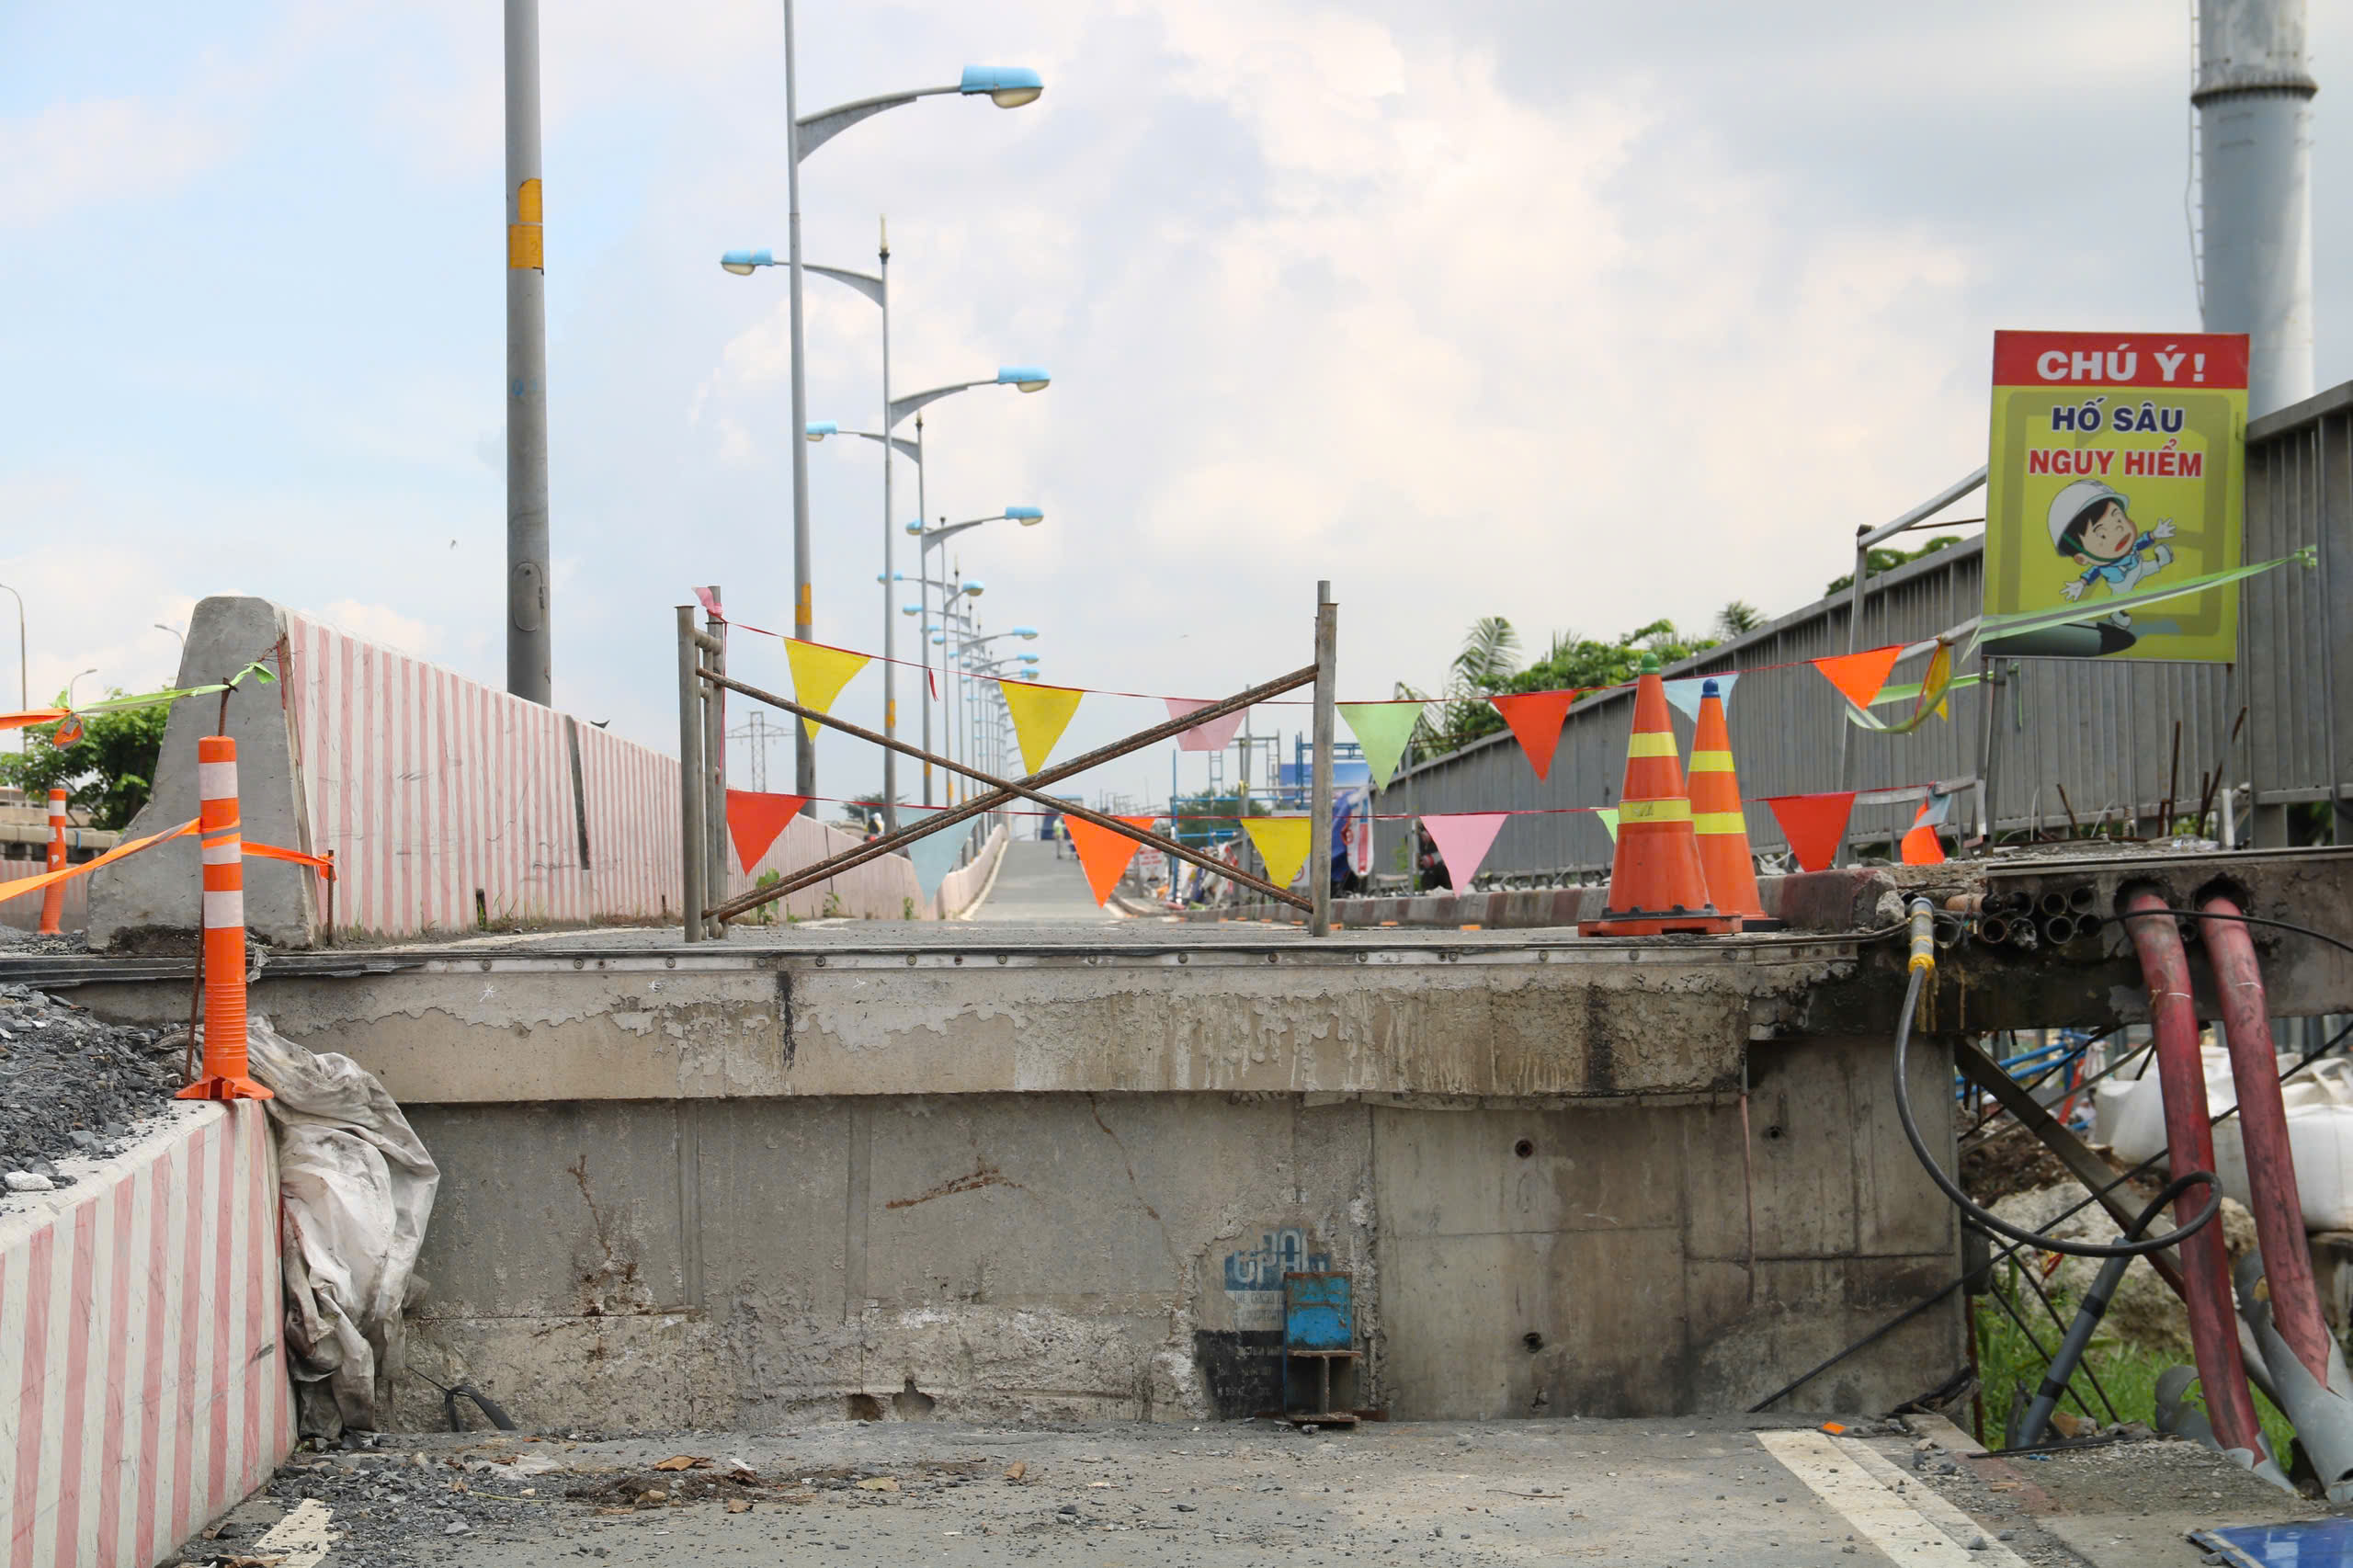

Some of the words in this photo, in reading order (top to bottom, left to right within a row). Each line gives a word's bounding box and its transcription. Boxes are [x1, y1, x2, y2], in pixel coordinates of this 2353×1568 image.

[2037, 344, 2138, 381] CHÚ
[2154, 345, 2205, 382] Ý!
[2052, 397, 2107, 431] HỐ
[2112, 402, 2184, 432] SÂU
[2029, 449, 2116, 475] NGUY
[2124, 438, 2203, 477] HIỂM
